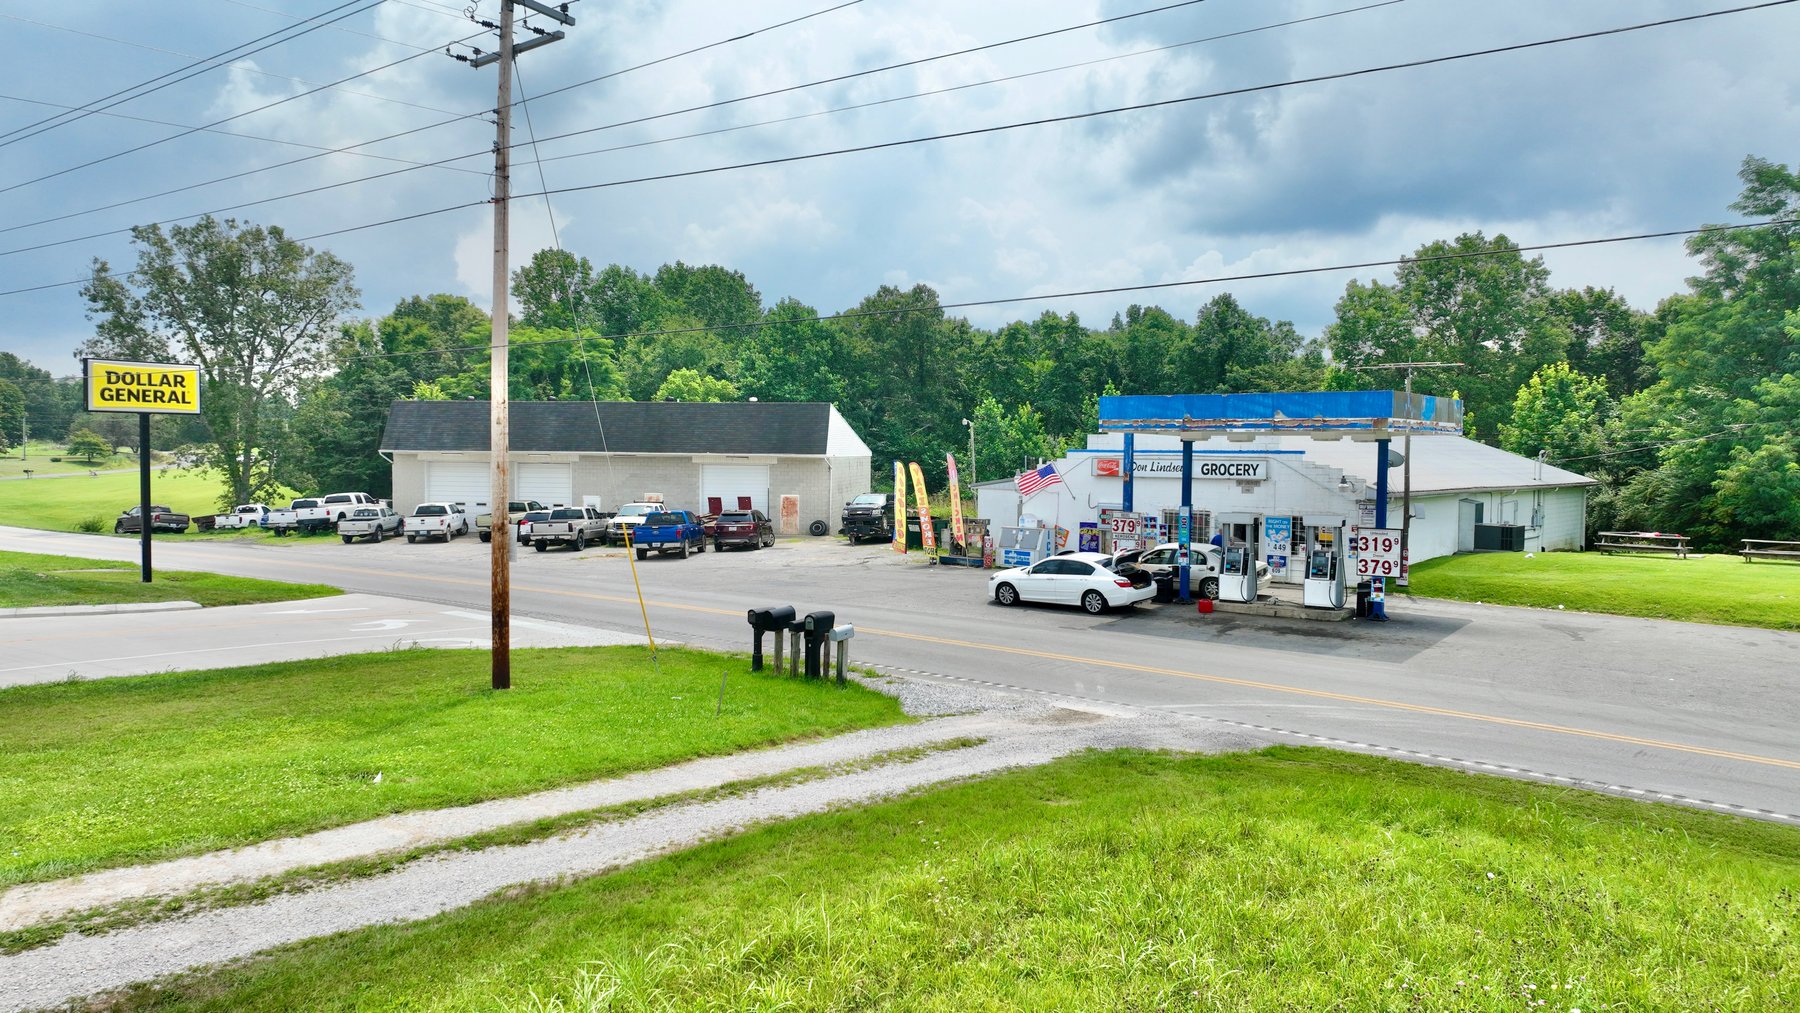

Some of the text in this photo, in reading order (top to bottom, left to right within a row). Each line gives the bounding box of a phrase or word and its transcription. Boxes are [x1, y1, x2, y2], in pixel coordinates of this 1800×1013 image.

[105, 370, 186, 388] DOLLAR
[100, 387, 191, 404] GENERAL
[1201, 463, 1259, 476] GROCERY
[1112, 519, 1135, 532] 379
[1359, 536, 1399, 552] 319 9
[1359, 559, 1391, 575] 379
